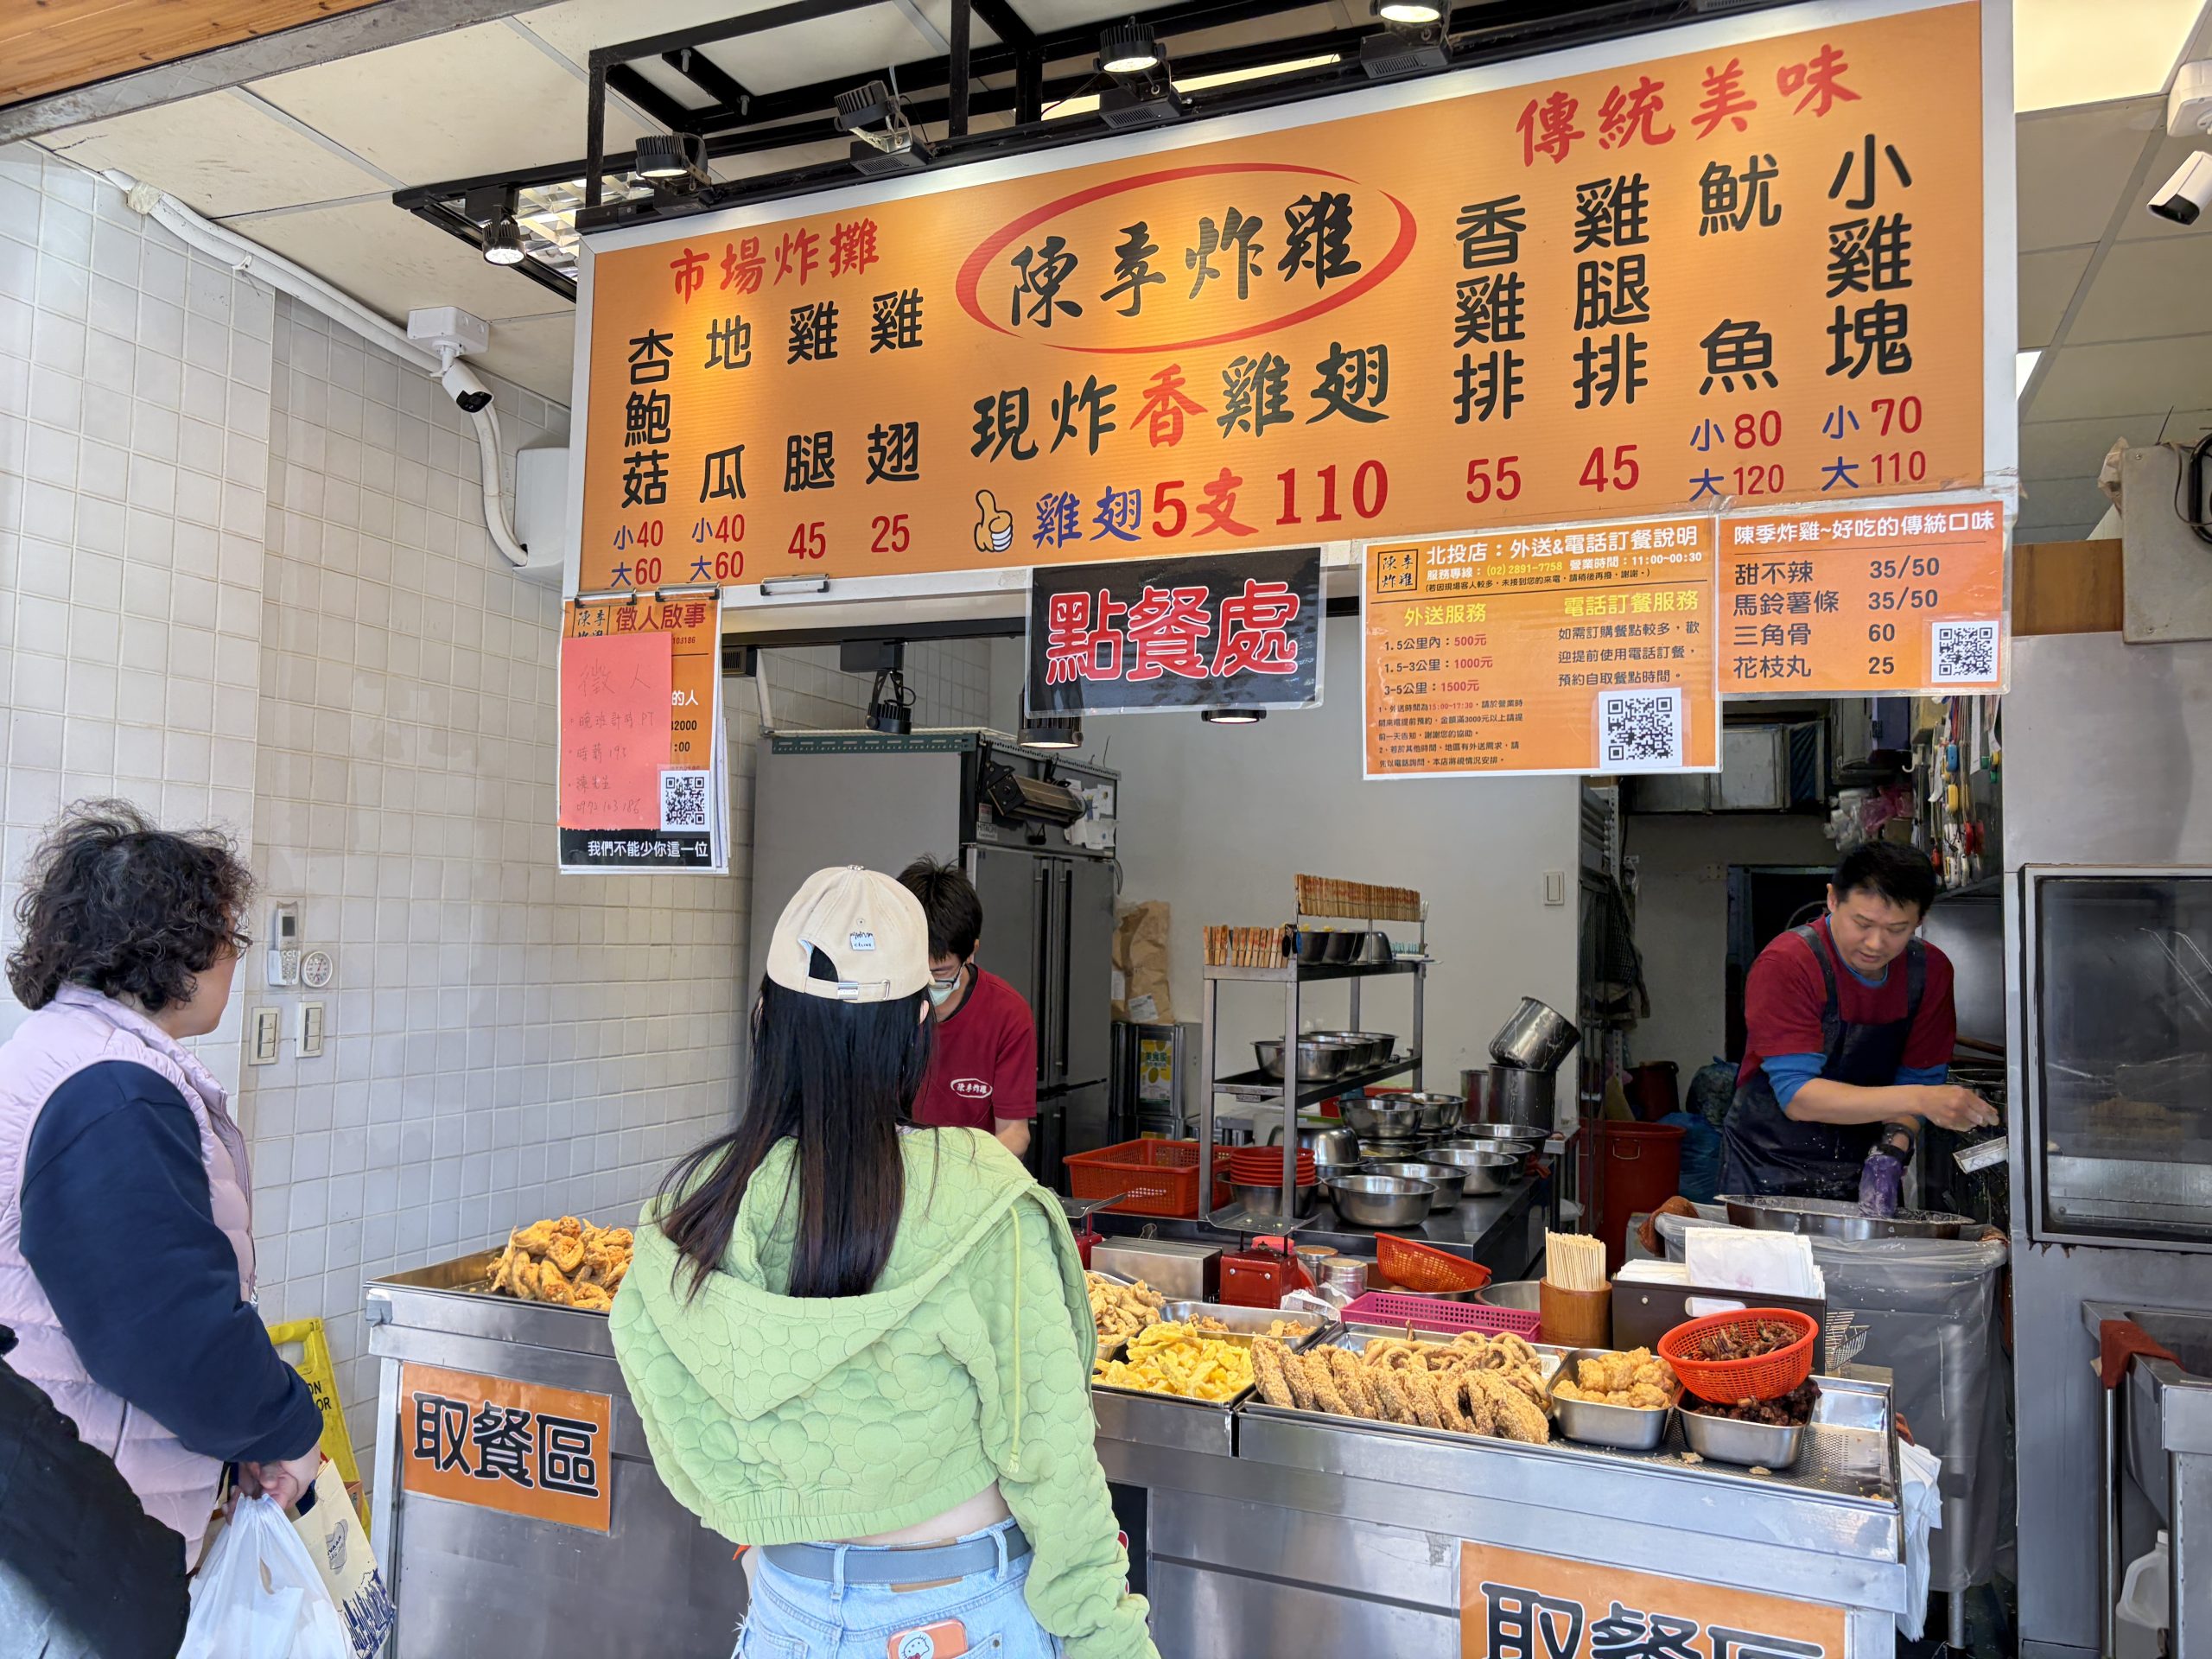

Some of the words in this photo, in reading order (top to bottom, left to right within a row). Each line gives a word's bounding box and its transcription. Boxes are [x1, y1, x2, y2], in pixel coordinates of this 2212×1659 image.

[1515, 43, 1863, 168] 傳統美味
[670, 217, 880, 305] 市場炸攤
[1010, 191, 1362, 327] 陳季炸雞
[1573, 173, 1650, 410] 雞腿排
[1698, 153, 1782, 397] 魷魚
[1825, 133, 1912, 380] 小雞塊
[1453, 194, 1527, 425] 香雞排
[621, 328, 674, 509] 杏鮑菇
[699, 315, 752, 504] 地瓜
[783, 300, 839, 493] 雞腿
[866, 288, 923, 486] 雞翅
[970, 341, 1389, 463] 現炸香雞翅
[1275, 460, 1389, 525] 110
[1465, 455, 1522, 505] 55
[1579, 443, 1639, 493] 45
[788, 521, 827, 560] 45
[870, 513, 911, 553] 25
[1734, 560, 1813, 586] 甜不辣
[1870, 555, 1940, 580] 35/50
[616, 602, 707, 632] 徵人啟事
[1046, 578, 1300, 685] 點餐處
[1404, 603, 1486, 627] 外送服務
[1564, 590, 1699, 616] 電話訂餐服務
[1732, 590, 1840, 617] 馬鈴薯條
[1868, 586, 1938, 611] 35/50
[1733, 622, 1812, 647] 三角骨
[1868, 623, 1896, 643] 60
[671, 690, 699, 706] 的人
[1733, 654, 1812, 679] 花枝丸
[1868, 657, 1895, 675] 25
[588, 840, 709, 858] 我們不能少你這一位
[412, 1390, 600, 1498] 取餐區
